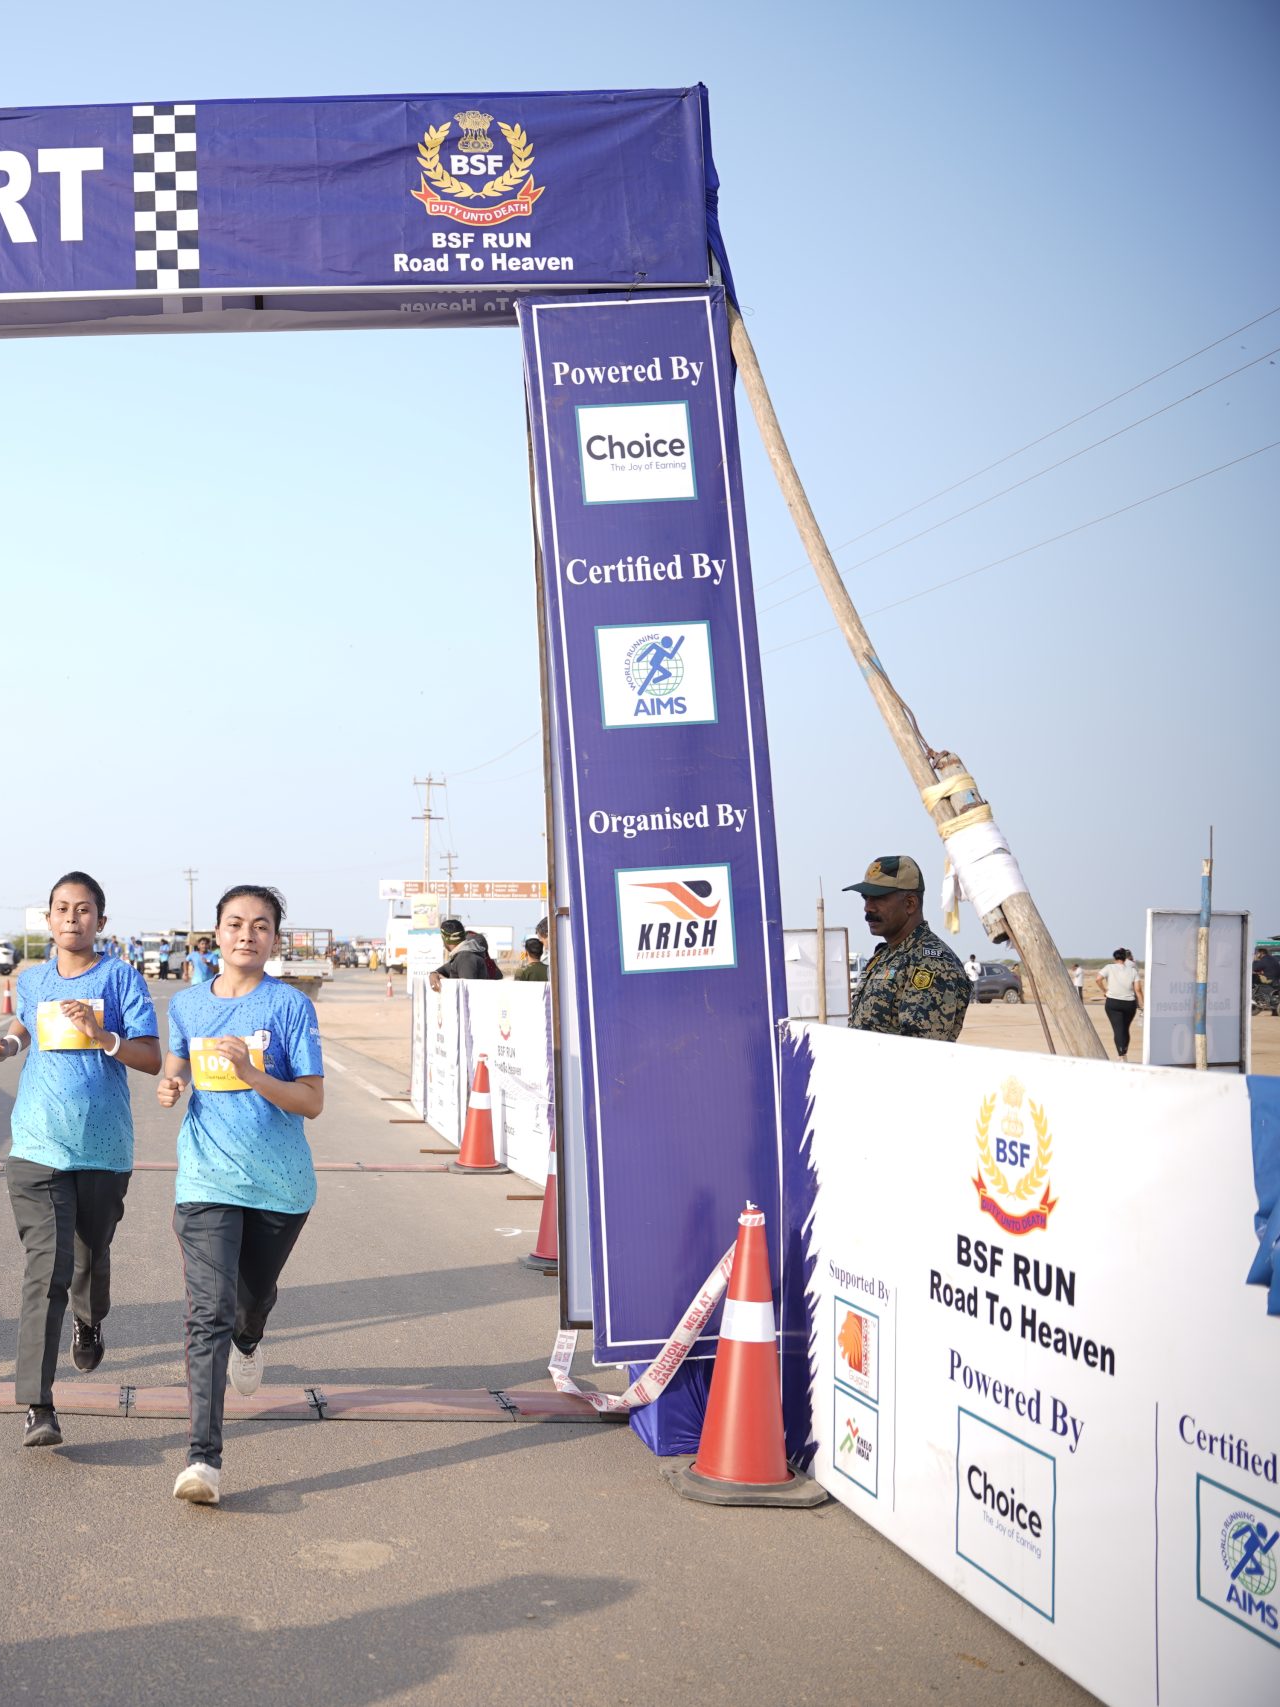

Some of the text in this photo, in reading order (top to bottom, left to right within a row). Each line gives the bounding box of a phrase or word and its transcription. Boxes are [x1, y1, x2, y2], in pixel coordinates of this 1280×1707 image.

[450, 154, 504, 176] BSF
[431, 203, 528, 222] DUTY UNTO DEATH
[431, 232, 532, 248] BSF RUN
[393, 252, 574, 272] Road To Heaven
[552, 355, 704, 386] Powered By
[586, 432, 686, 461] Choice
[610, 461, 687, 473] The Joy of Earning
[566, 552, 727, 585] Certified By
[625, 633, 660, 692] WORLD RUNNING
[634, 697, 687, 717] AIMS
[588, 803, 748, 838] Organised By
[637, 919, 718, 951] KRISH
[636, 947, 716, 960] FITNESS ACADEMY
[995, 1137, 1031, 1169] BSF
[980, 1198, 1047, 1232] DUTY UNTO DEATH
[828, 1258, 891, 1307] Supported By
[956, 1233, 1076, 1308] BSF RUN
[683, 1291, 715, 1332] MEN AT
[929, 1268, 1116, 1377] Road To Heaven
[648, 1340, 683, 1381] CAUTION
[658, 1344, 690, 1387] DANGER
[947, 1347, 1085, 1454] Powered By
[857, 1436, 872, 1453] KHELO
[1178, 1414, 1278, 1485] Certified
[967, 1464, 1042, 1538] Choice
[983, 1510, 994, 1526] The
[995, 1519, 1007, 1537] Joy
[1220, 1511, 1256, 1572] WORLD RUNNING
[1226, 1583, 1279, 1631] AIMS
